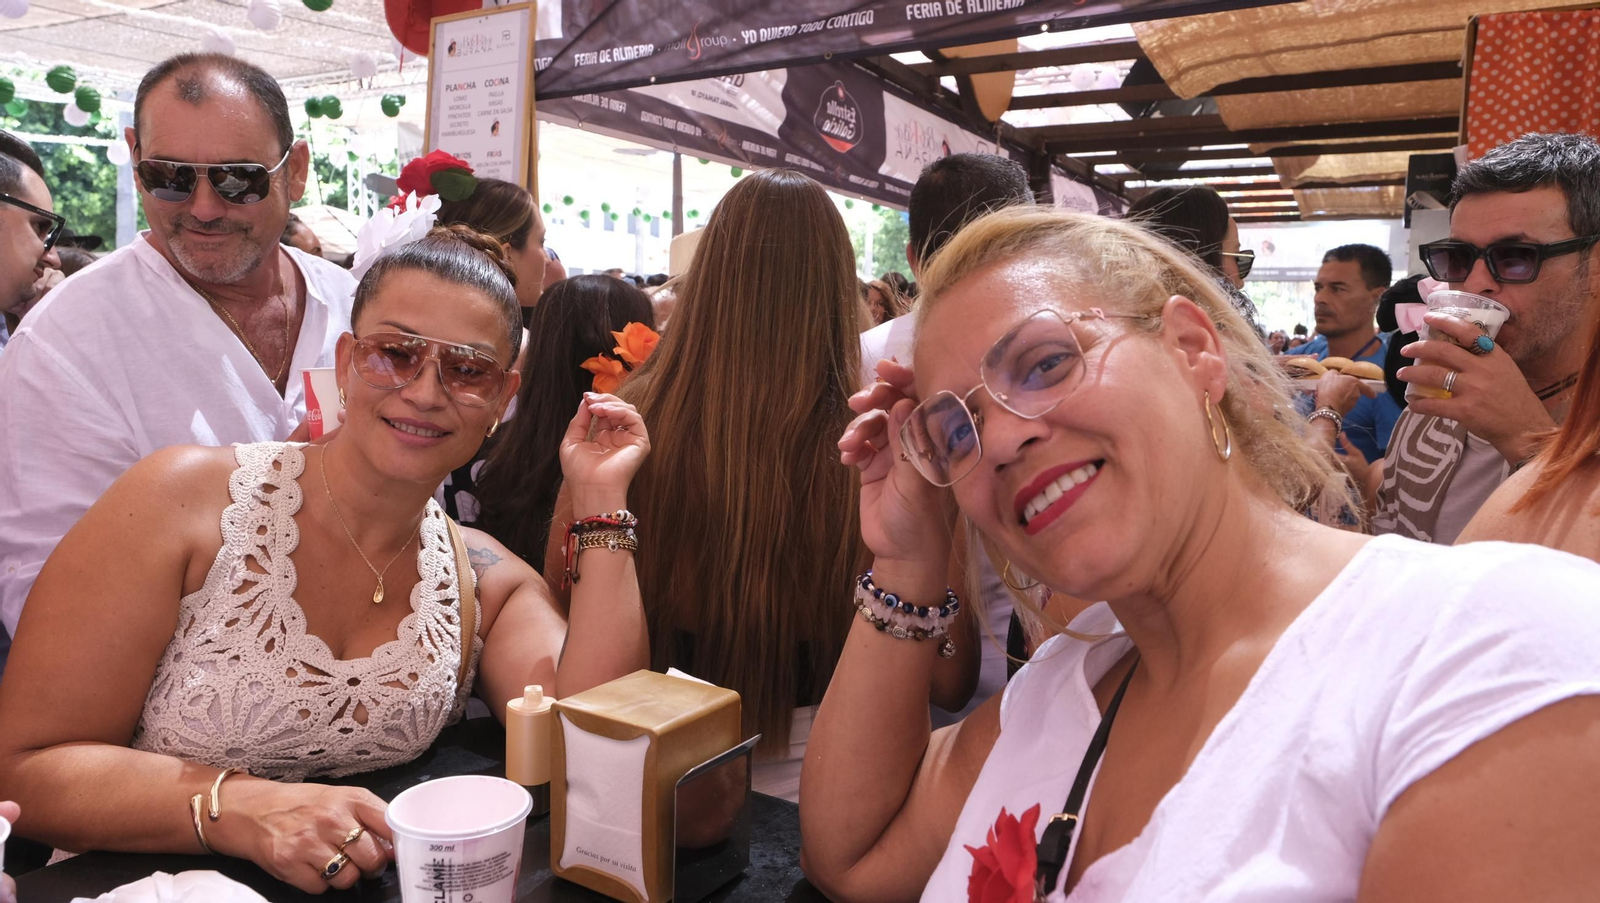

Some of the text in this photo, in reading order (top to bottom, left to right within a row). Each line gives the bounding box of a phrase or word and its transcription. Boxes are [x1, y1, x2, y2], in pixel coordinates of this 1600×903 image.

[906, 1, 943, 20] FERIA
[945, 0, 963, 16] DE
[741, 10, 874, 44] YO QUIERO TODO CONTIGO
[574, 51, 598, 67] FERIA
[599, 48, 612, 63] DE
[612, 43, 654, 62] ALMERIA
[445, 81, 477, 92] PLANCHA
[484, 76, 509, 88] COCINA
[448, 112, 471, 120] PINCHITOS
[477, 109, 492, 117] CARNE
[441, 129, 476, 137] HAMBURGUESA
[429, 844, 455, 852] 300 ml
[575, 846, 599, 860] Gracias
[600, 855, 611, 864] por
[619, 862, 637, 872] visita
[433, 857, 446, 903] LAME
